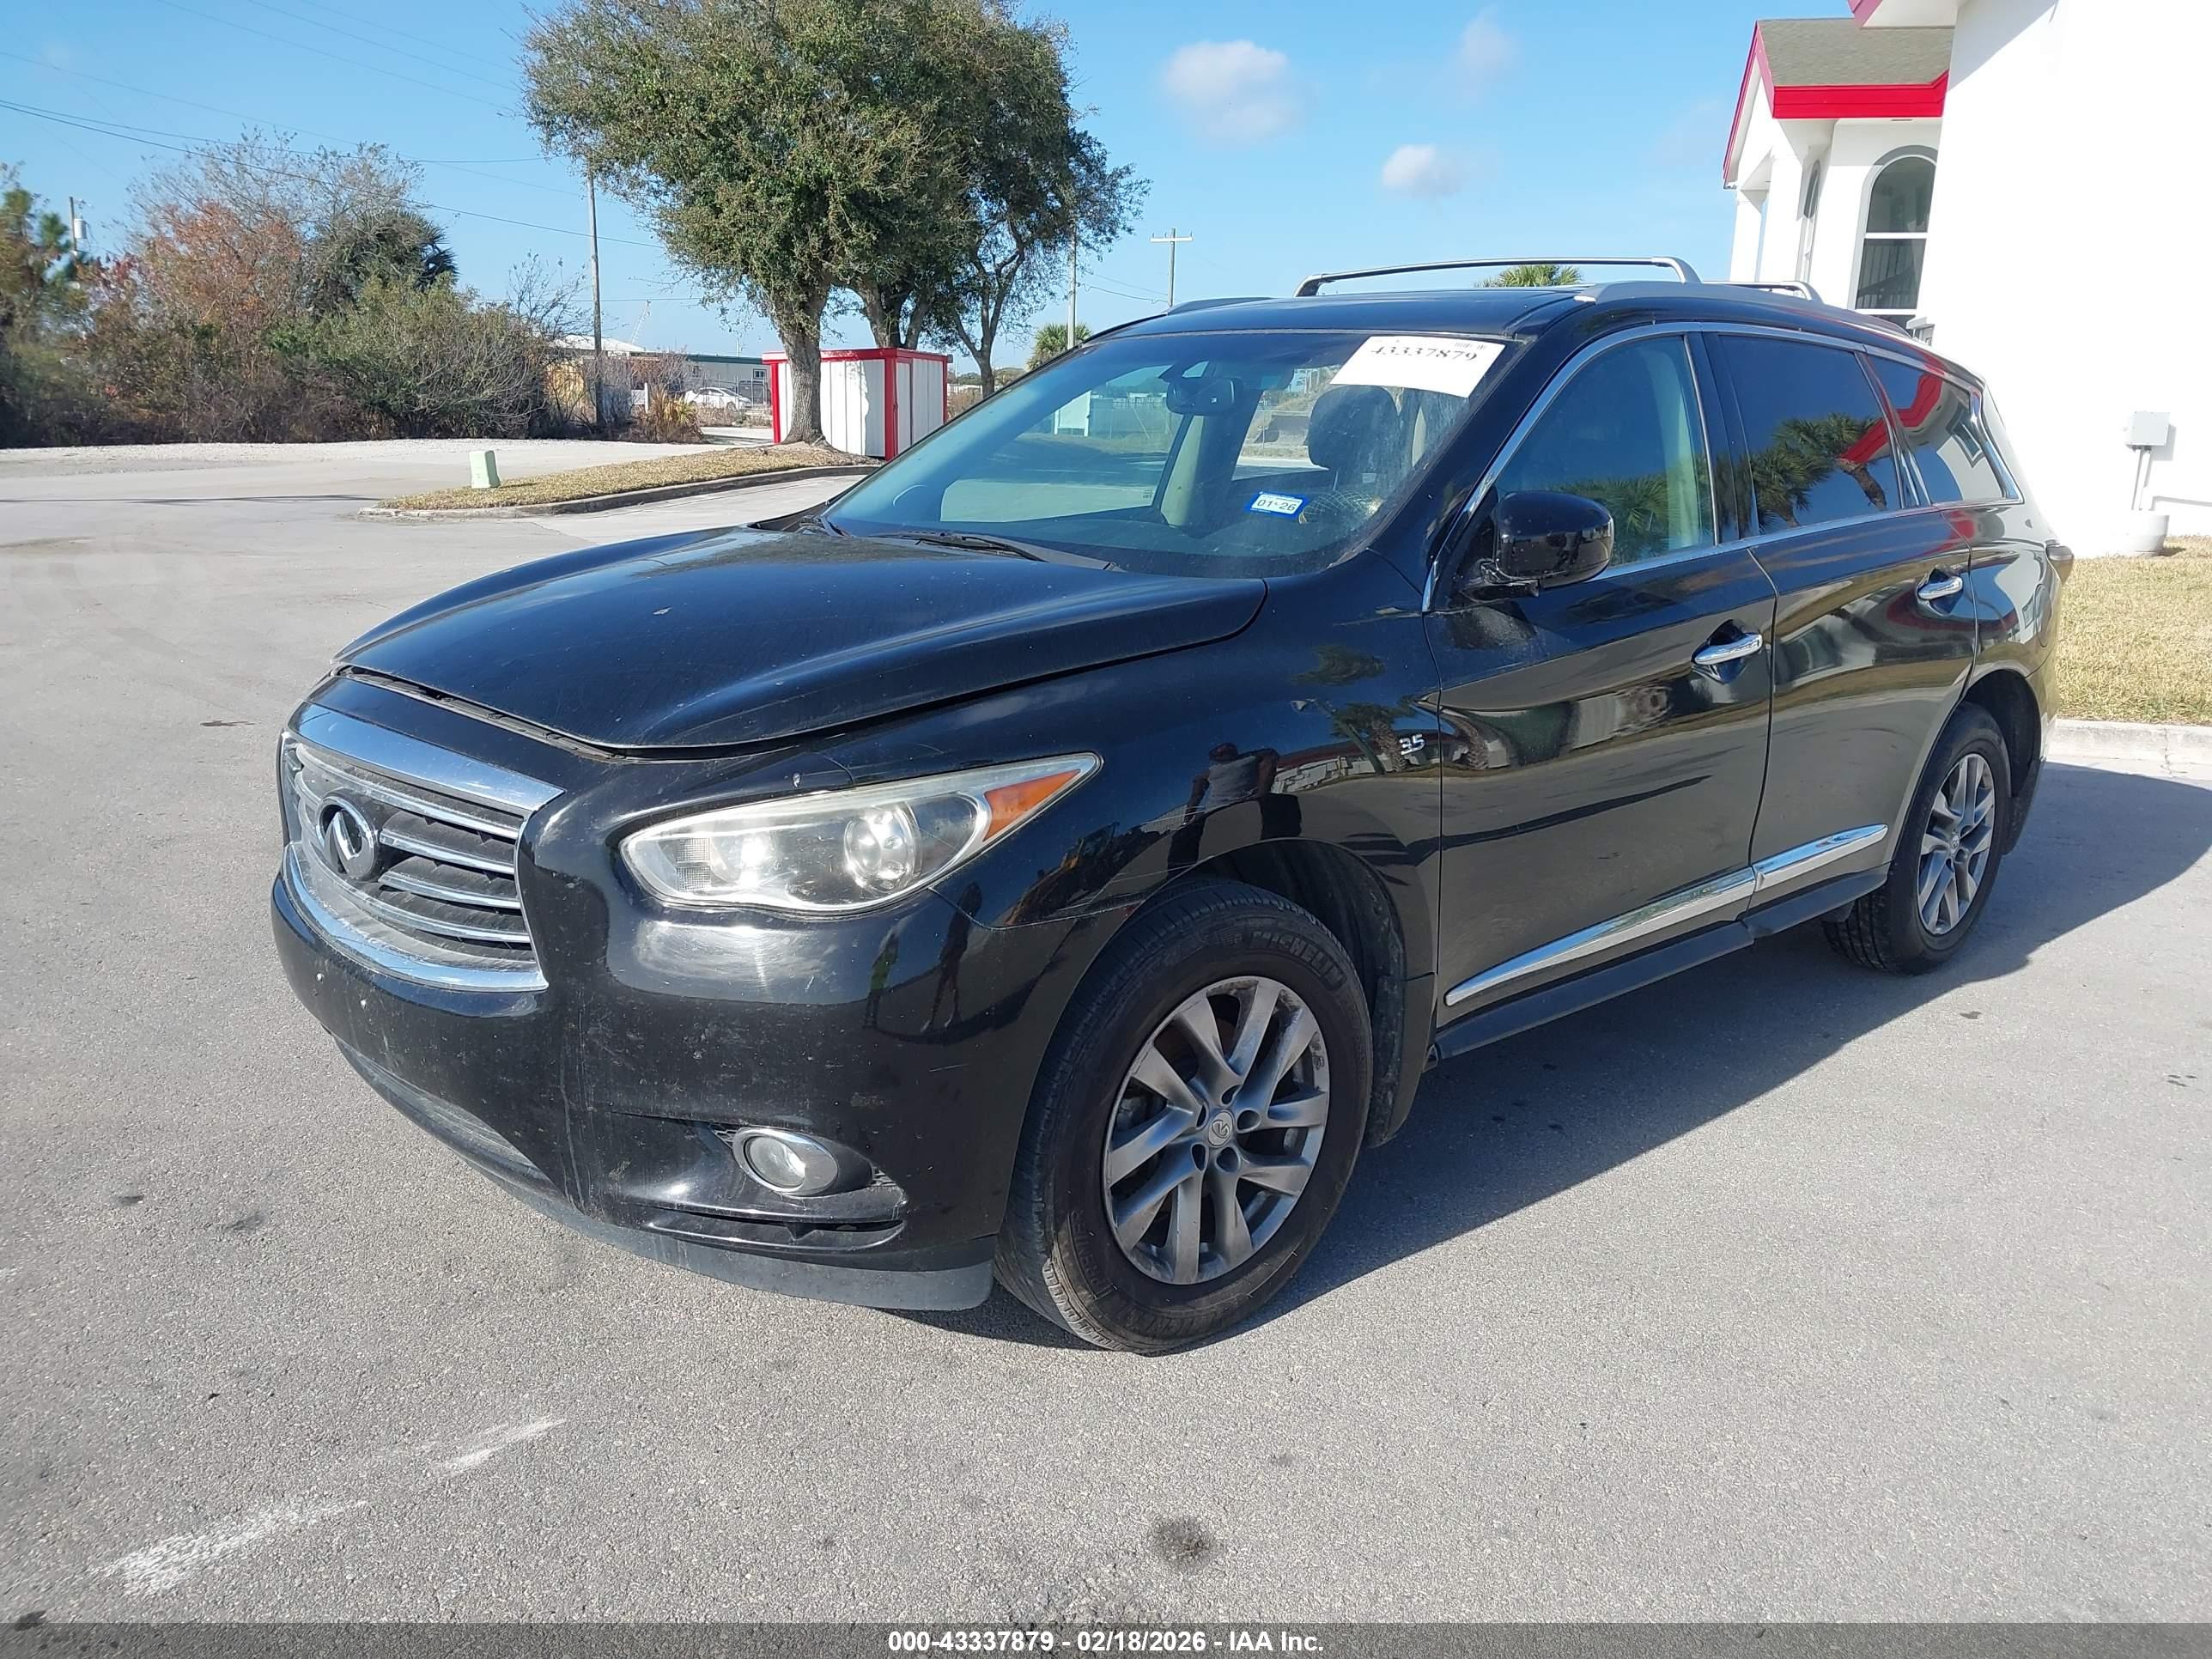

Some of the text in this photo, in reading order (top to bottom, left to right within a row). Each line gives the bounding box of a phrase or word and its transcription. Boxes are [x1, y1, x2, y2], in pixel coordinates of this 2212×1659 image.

[1371, 345, 1478, 361] 43337879
[1256, 499, 1273, 507] 01
[1279, 502, 1297, 511] 26
[1250, 930, 1346, 988] MICHELIN
